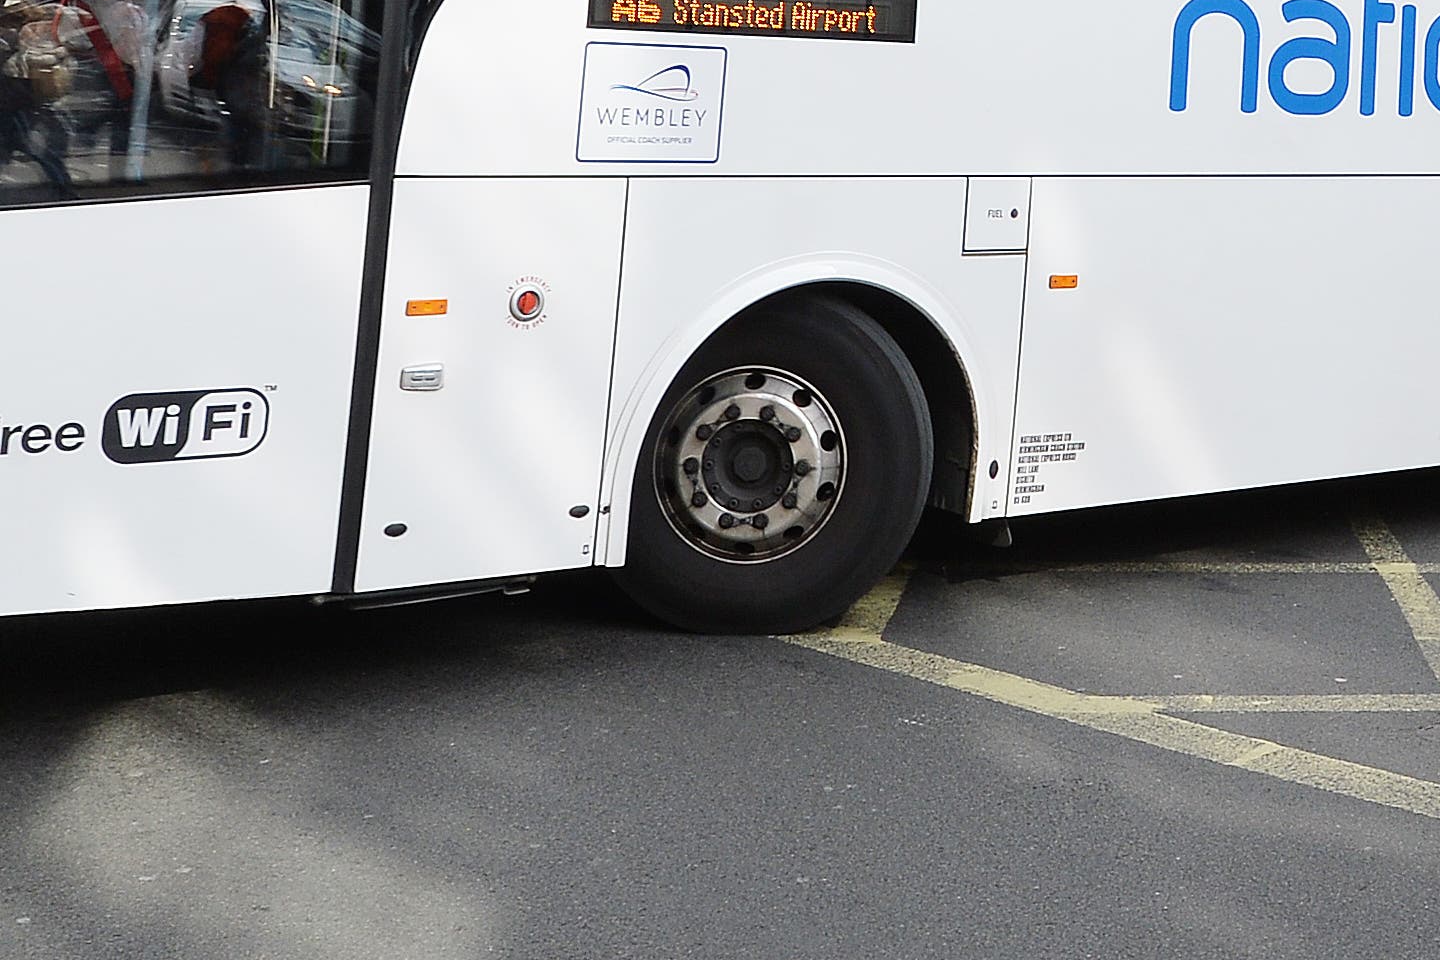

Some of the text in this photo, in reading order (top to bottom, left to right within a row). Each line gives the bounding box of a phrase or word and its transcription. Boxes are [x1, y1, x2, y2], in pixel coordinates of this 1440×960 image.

[791, 1, 878, 33] Airport
[596, 107, 707, 127] WEMBLEY
[987, 209, 1003, 218] FUEL
[0, 419, 85, 455] ree
